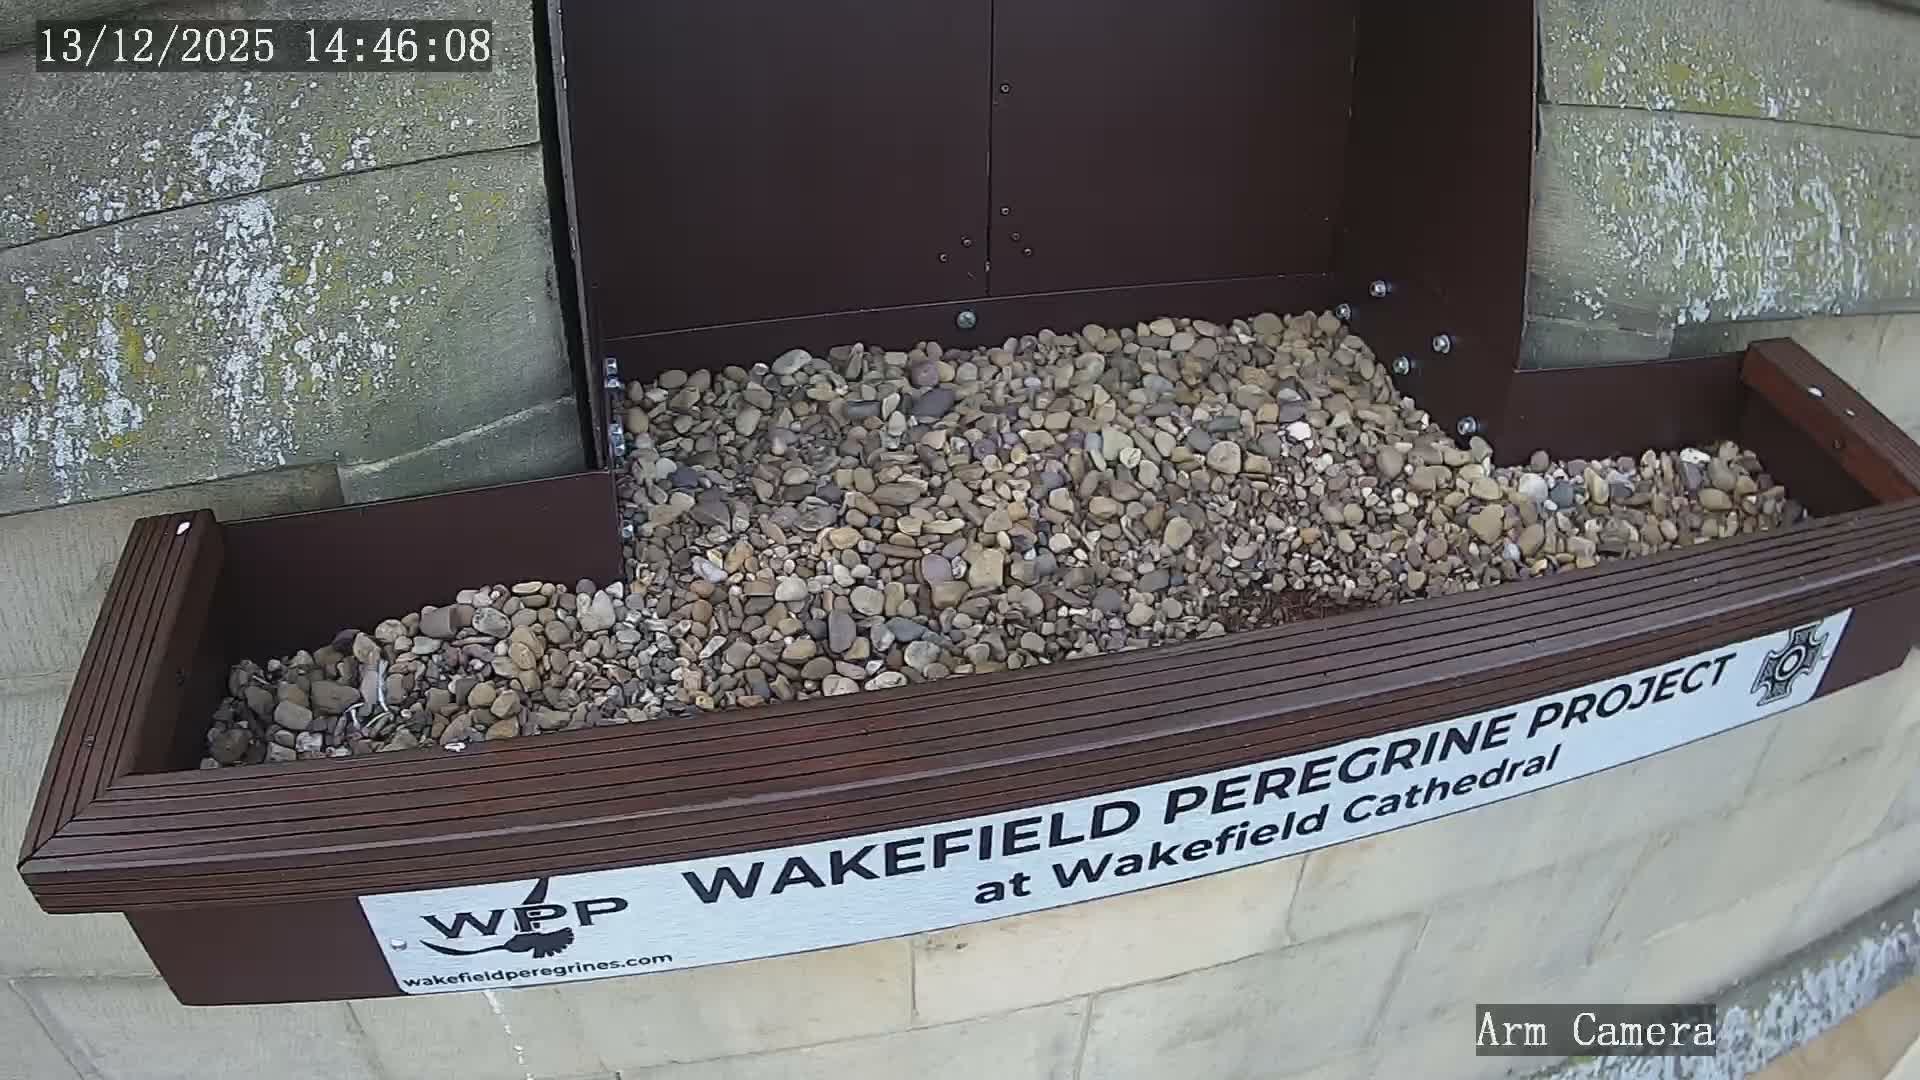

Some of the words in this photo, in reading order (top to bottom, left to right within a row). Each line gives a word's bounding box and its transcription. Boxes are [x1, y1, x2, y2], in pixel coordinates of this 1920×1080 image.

[683, 800, 1140, 904] WAKEFIELD
[1165, 713, 1511, 824] PEREGRINE
[1528, 652, 1738, 740] PROJECT
[974, 869, 1031, 904] at
[1055, 810, 1324, 888] Wakefield
[1343, 744, 1562, 825] Cathedral
[421, 896, 629, 940] WPP
[402, 952, 674, 989] wakefieldperegrines.com
